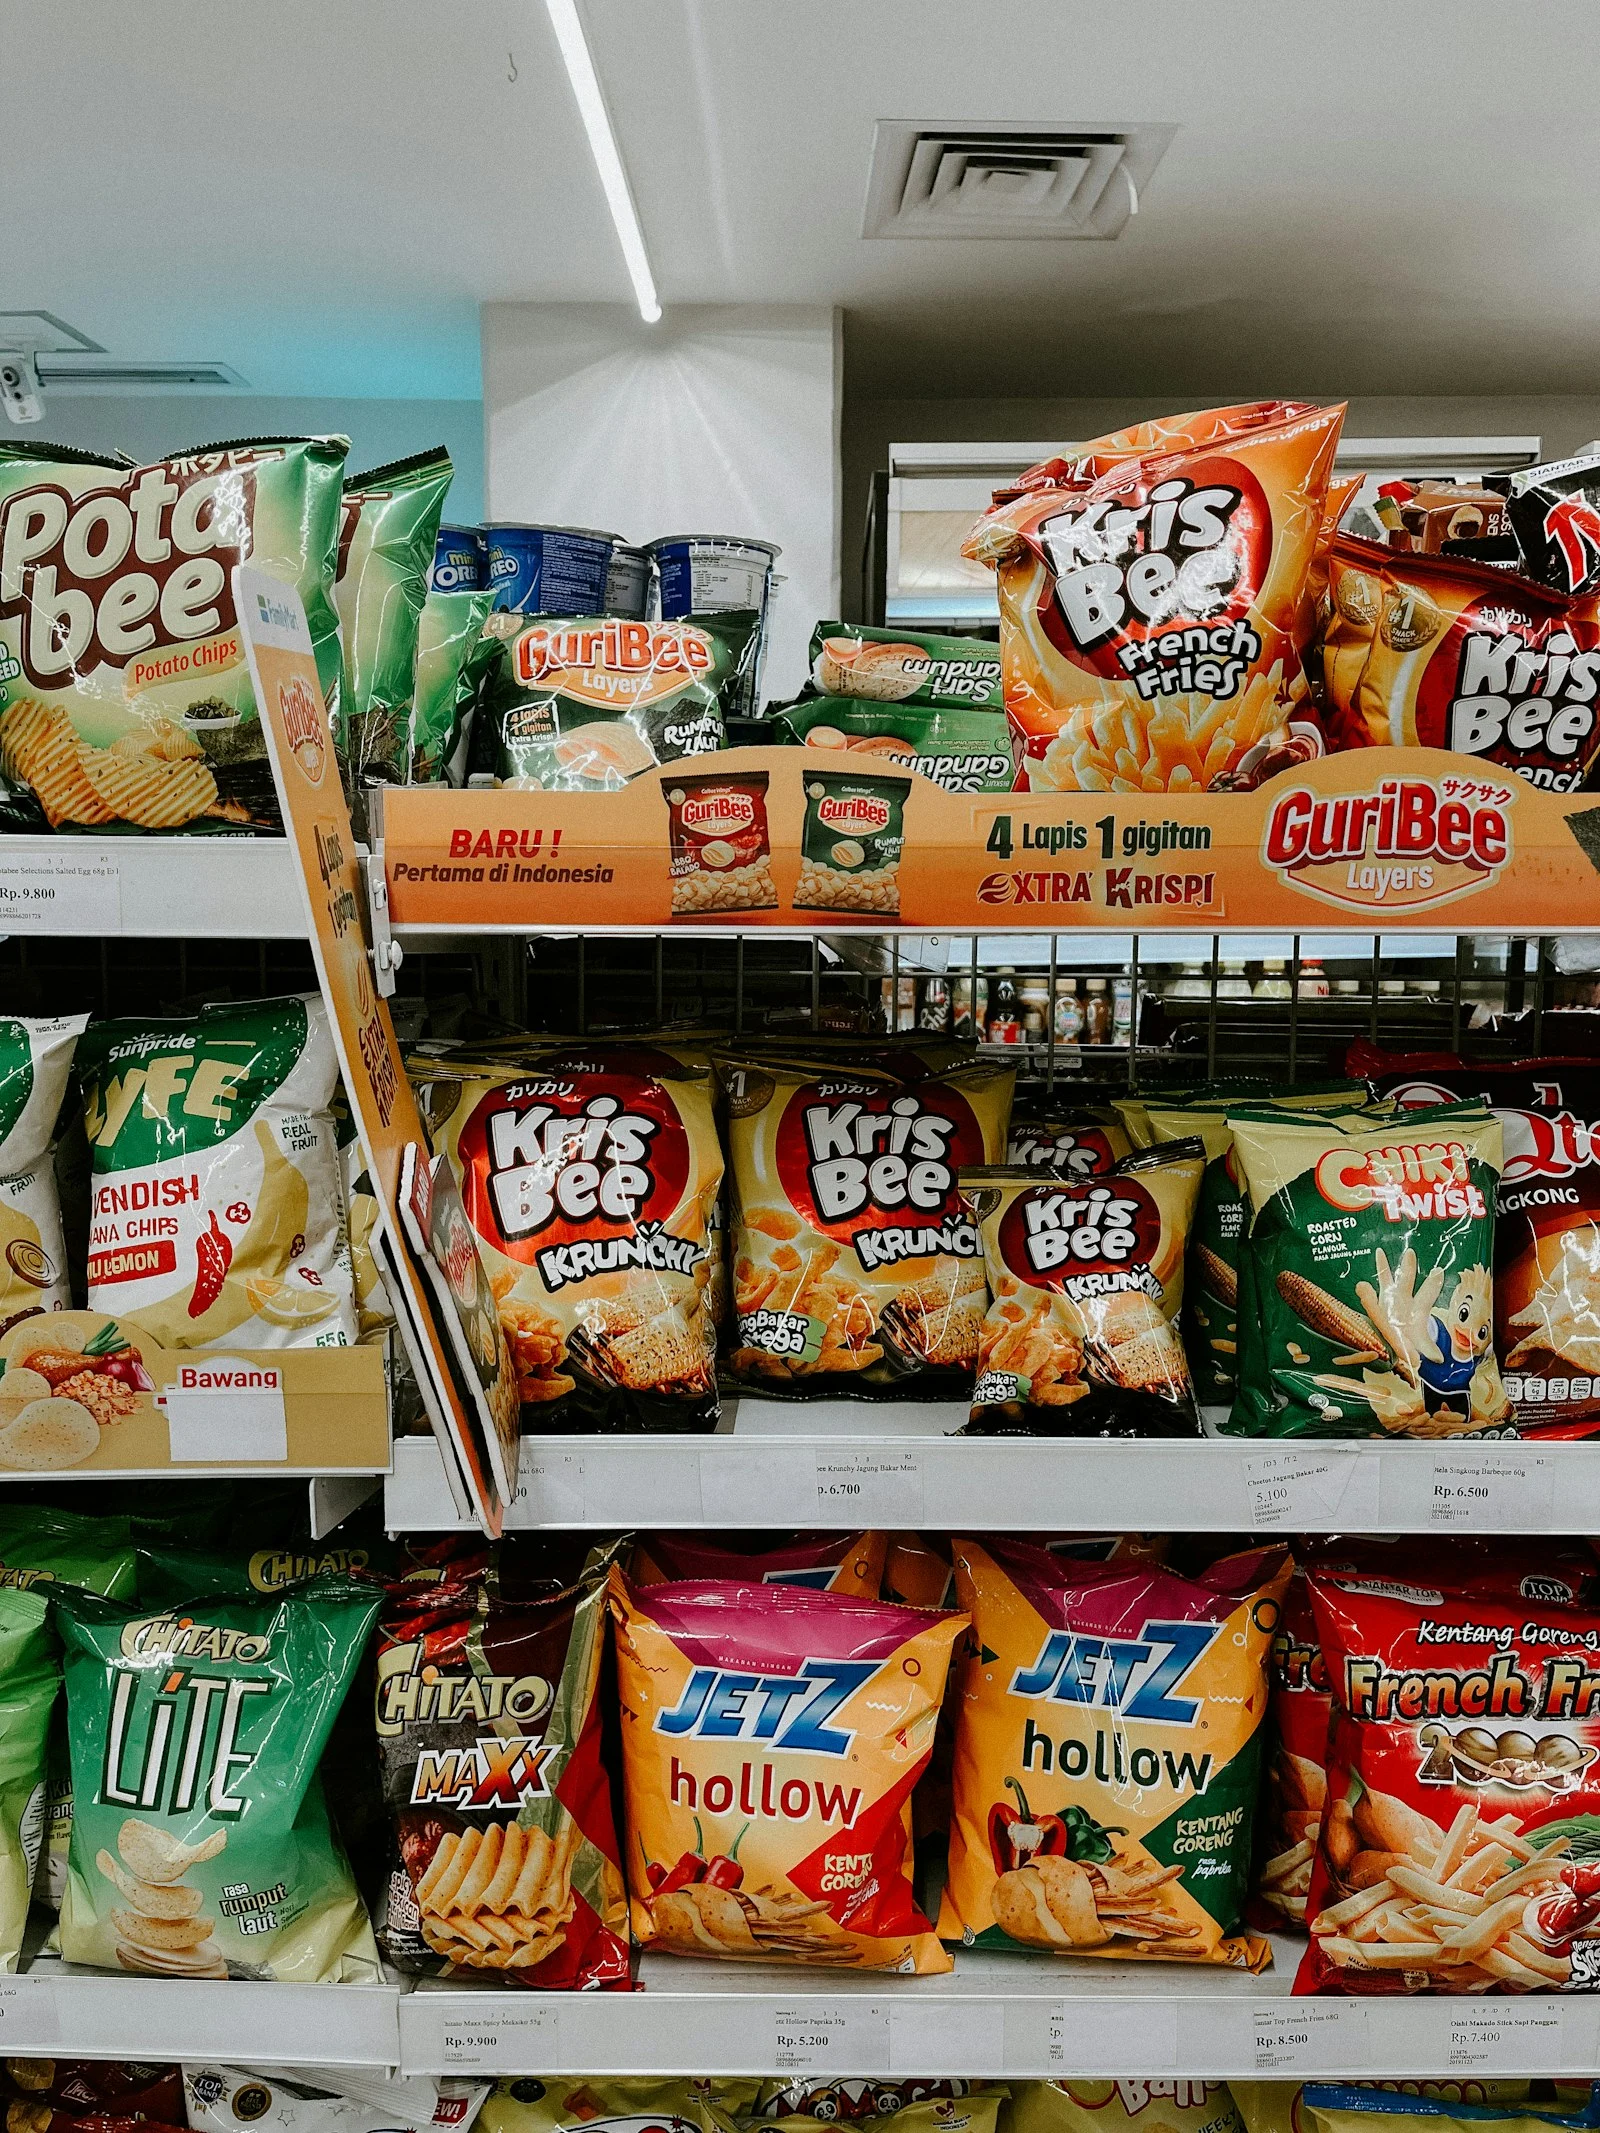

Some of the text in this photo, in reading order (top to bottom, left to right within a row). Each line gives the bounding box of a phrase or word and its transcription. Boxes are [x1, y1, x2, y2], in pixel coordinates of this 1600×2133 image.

[1529, 458, 1586, 478] SIANTAR
[1041, 481, 1242, 579] Kris
[30, 558, 226, 677] bee
[1388, 595, 1417, 630] #1
[1390, 627, 1417, 638] SNACK
[518, 620, 711, 681] GuriBee
[1118, 622, 1259, 673] French
[134, 639, 239, 685] Potato Chips
[903, 659, 1001, 684] andum
[1460, 632, 1600, 697] Kris
[581, 669, 654, 697] Layers
[929, 677, 994, 702] Sari
[1135, 659, 1247, 699] Fries
[522, 721, 553, 736] gigitan
[1452, 699, 1591, 757] Bee
[1443, 778, 1513, 806] サクサク
[683, 797, 752, 824] GuriBee
[819, 797, 889, 825] GuriBee
[985, 814, 1212, 860] 4 Lapis 1 gigitan
[1264, 780, 1510, 870] GuriBee
[448, 828, 564, 860] BARU !
[20, 867, 105, 876] Selections Salted Egg 68g
[392, 862, 614, 884] Pertama di Indonesia
[669, 861, 700, 878] BALADO
[674, 855, 693, 868] BBQ
[1105, 868, 1217, 910] KRISPI
[1346, 861, 1435, 899] Layers
[0, 887, 56, 901] Rp. 9.800
[505, 1080, 575, 1102] カリカリ
[725, 1070, 747, 1098] #1
[817, 1082, 880, 1099] カリカリ
[281, 1124, 312, 1139] REAL
[491, 1096, 656, 1170] Kris
[806, 1097, 954, 1162] Kris
[291, 1135, 319, 1151] FRUIT
[10, 1173, 36, 1196] FRUIT
[811, 1156, 951, 1219] Bee
[492, 1164, 650, 1235] Bee
[1025, 1188, 1140, 1235] Kris
[1375, 1183, 1488, 1223] Twist
[126, 1216, 179, 1241] CHIPS
[1306, 1216, 1358, 1234] ROASTED
[1026, 1226, 1137, 1271] Bee
[1310, 1231, 1343, 1246] CORN
[1311, 1242, 1348, 1256] FLAVOUR
[103, 1248, 160, 1279] LEMON
[542, 1236, 706, 1288] KRUNCHY
[180, 1367, 278, 1390] Bawang
[828, 1465, 855, 1474] Krunchy
[856, 1465, 879, 1473] Jagung
[1449, 1466, 1526, 1477] Singkong Barbeque 60g
[829, 1484, 861, 1495] 6.700
[1255, 1487, 1288, 1503] 5.100
[1433, 1485, 1489, 1499] Rp. 6.500
[1529, 1580, 1565, 1598] TOP
[1416, 1619, 1600, 1651] Kentang Goreng
[1012, 1622, 1226, 1726] JETZ
[1348, 1656, 1529, 1720] French
[656, 1660, 888, 1758] JETZ
[1021, 1718, 1212, 1794] hollow
[669, 1755, 862, 1828] hollow
[1176, 1806, 1244, 1836] KENTANG
[1172, 1831, 1234, 1855] GORENG
[1192, 1861, 1233, 1882] paprika
[221, 1883, 288, 1916] rumput
[223, 1883, 250, 1898] rasa
[279, 1902, 296, 1916] Nori
[238, 1912, 278, 1935] laut
[809, 2018, 833, 2026] Paprika
[833, 2018, 846, 2026] 35g
[1273, 2018, 1286, 2027] Top
[1286, 2016, 1308, 2025] French
[445, 2036, 498, 2049] Rp. 9.900
[777, 2035, 830, 2048] Rp. 5.200
[1256, 2033, 1309, 2049] Rp. 8.500
[1450, 2031, 1501, 2045] Rp. 7.400
[198, 2077, 223, 2091] TOP
[433, 2102, 461, 2119] EW!
